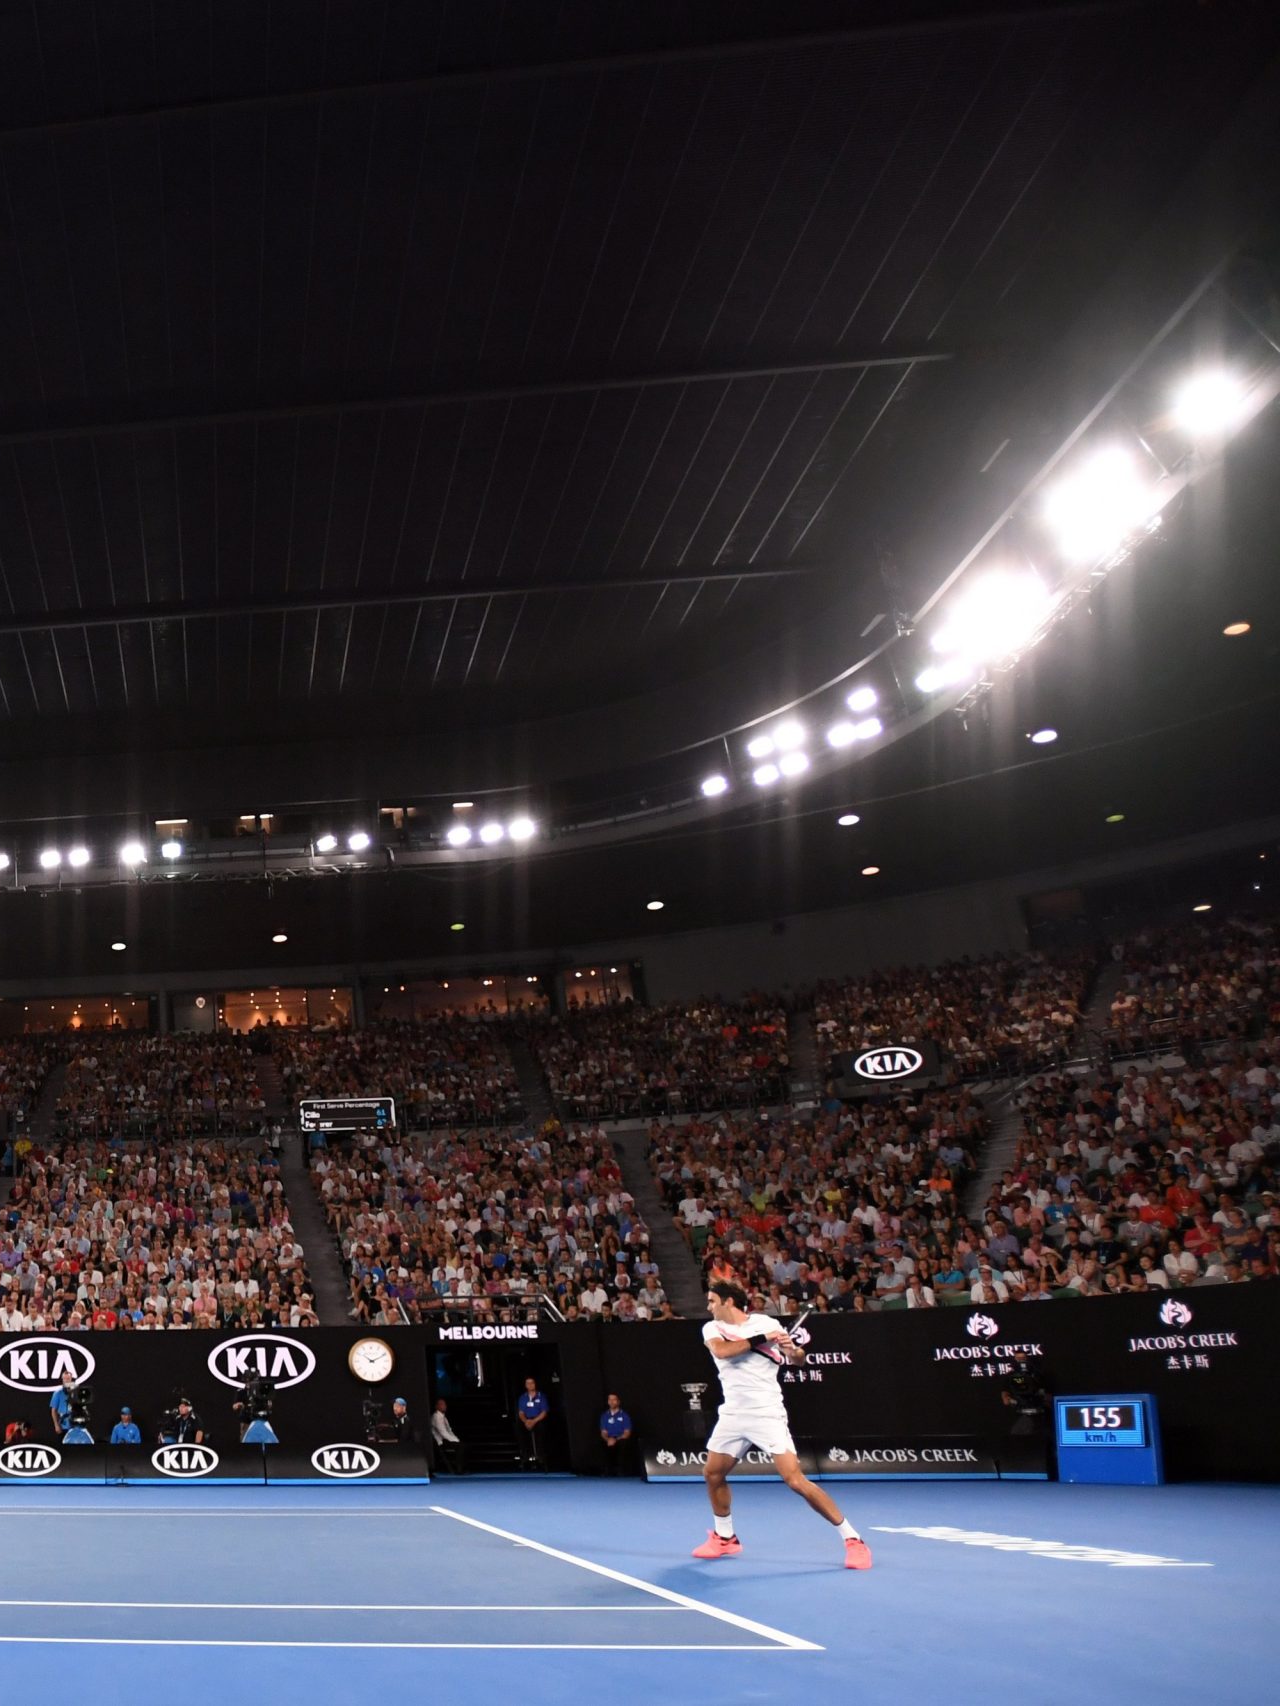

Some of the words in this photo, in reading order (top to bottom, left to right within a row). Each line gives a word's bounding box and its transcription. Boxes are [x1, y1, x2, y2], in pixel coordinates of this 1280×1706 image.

[865, 1053, 912, 1074] KIA
[439, 1325, 538, 1340] MELBOURNE
[934, 1345, 991, 1361] JACOB'S
[1128, 1335, 1187, 1353] JACOB'S
[1188, 1333, 1238, 1348] CREEK
[9, 1350, 78, 1379] KIA
[226, 1347, 298, 1377] KIA
[805, 1352, 852, 1365] CREEK
[1080, 1407, 1121, 1428] 155
[1085, 1432, 1117, 1443] km/h
[7, 1450, 50, 1469] KIA
[163, 1450, 208, 1470] KIA
[322, 1450, 368, 1470] KIA
[853, 1448, 918, 1463] JACOB'S
[921, 1449, 978, 1462] CREEK
